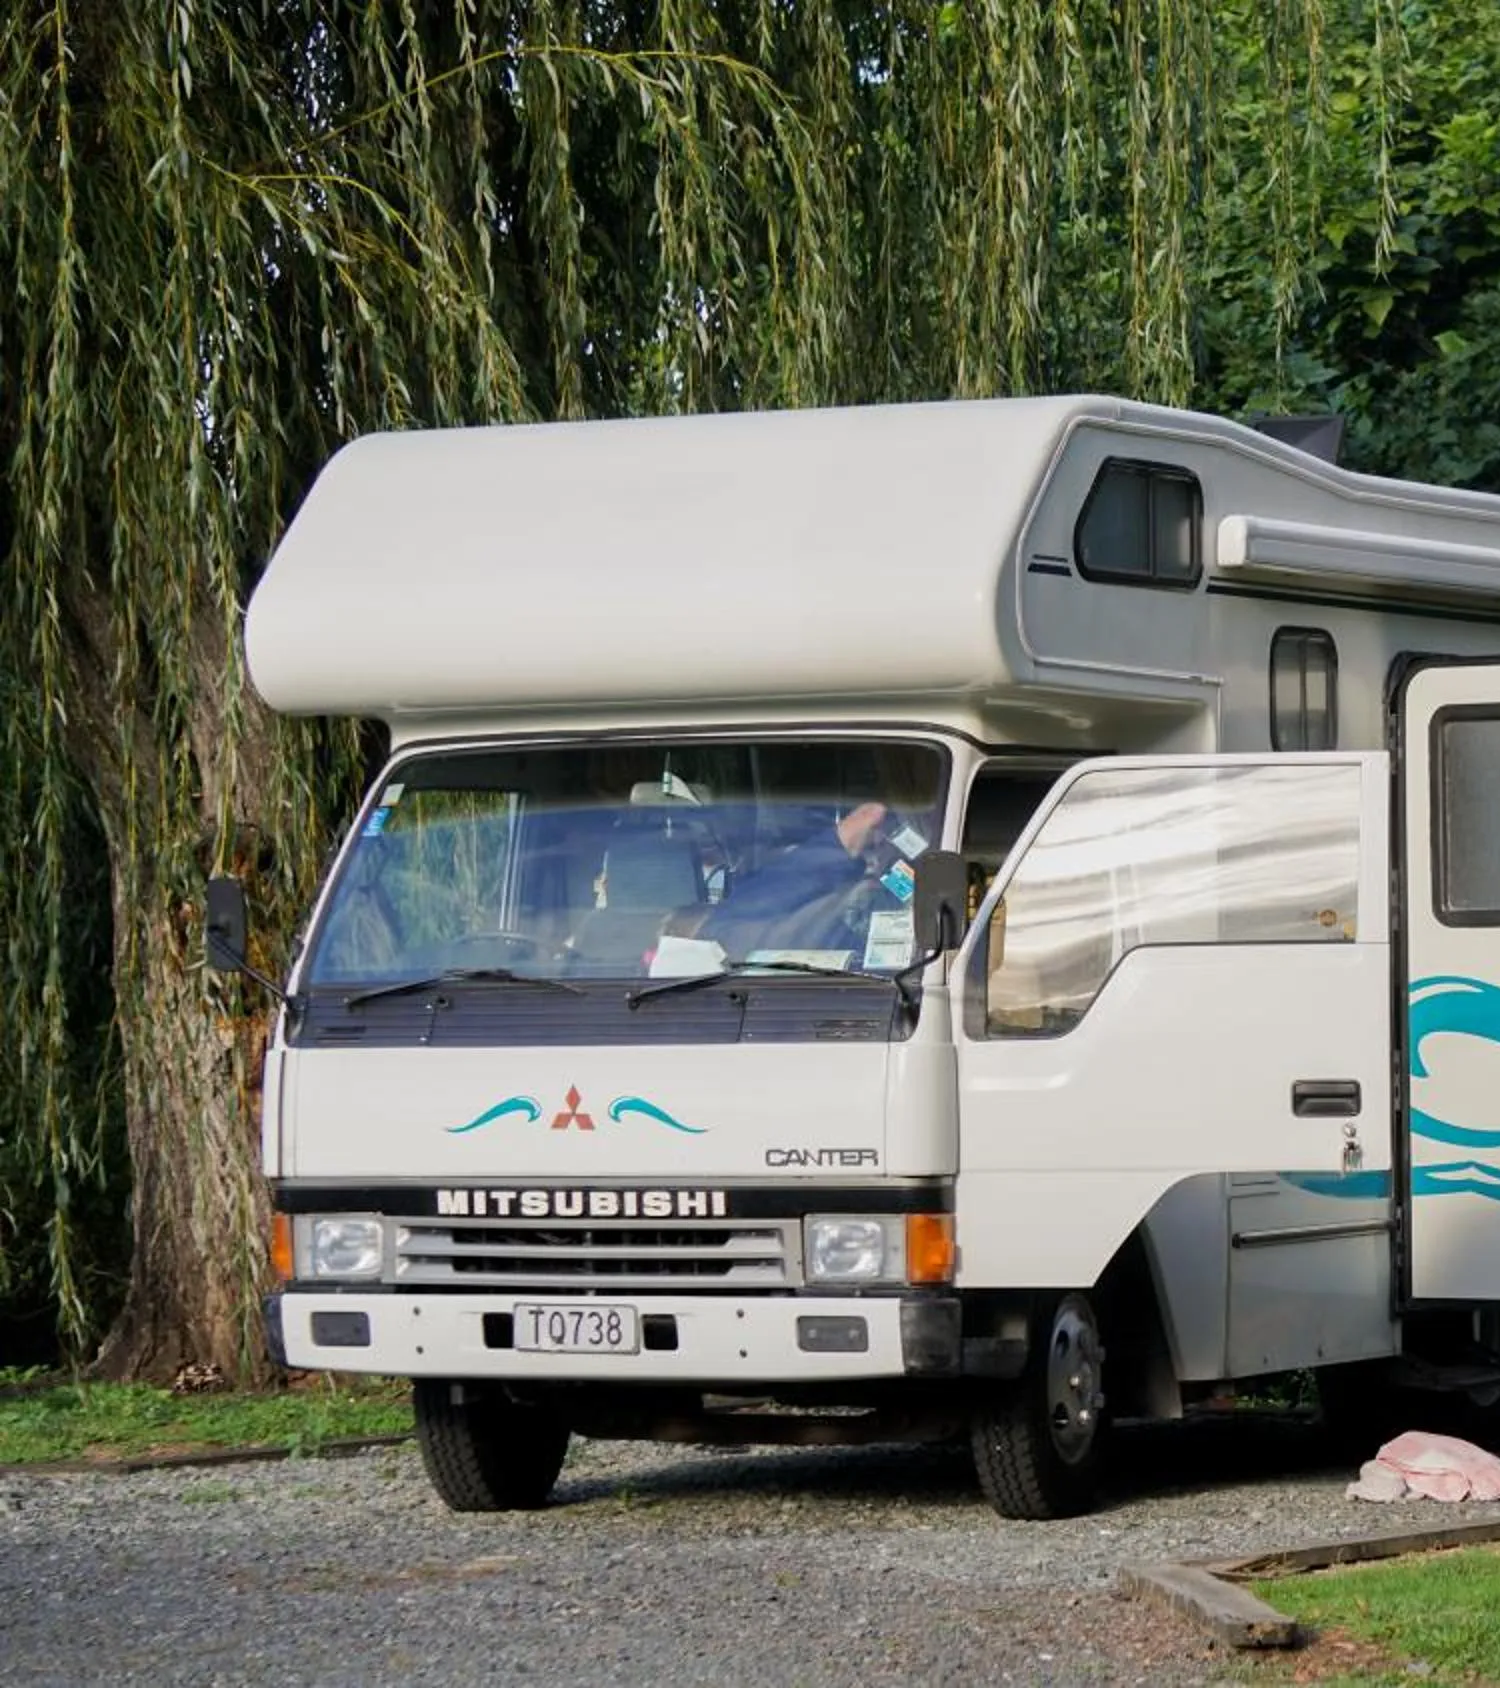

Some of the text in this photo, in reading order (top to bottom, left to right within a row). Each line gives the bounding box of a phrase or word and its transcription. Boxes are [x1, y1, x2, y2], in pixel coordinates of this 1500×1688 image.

[765, 1148, 879, 1167] CANTER
[436, 1189, 727, 1217] MITSUBISHI
[527, 1309, 623, 1345] TQ738
